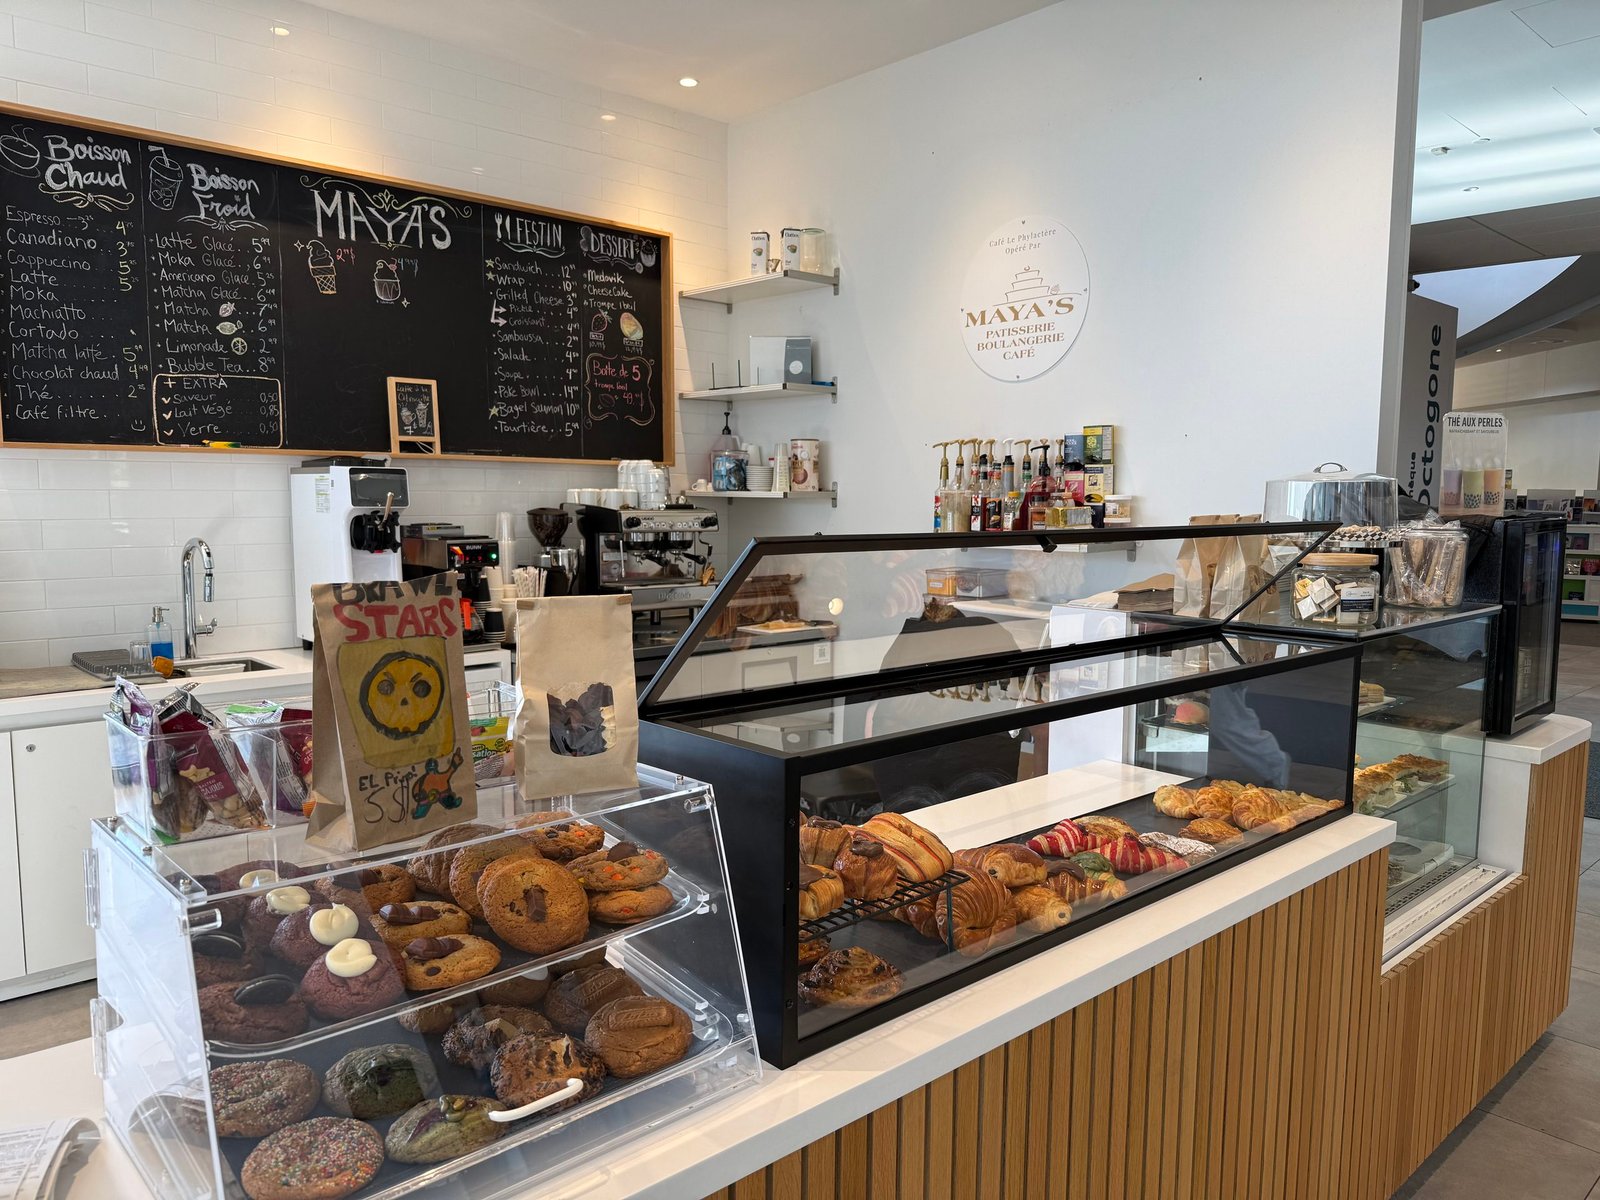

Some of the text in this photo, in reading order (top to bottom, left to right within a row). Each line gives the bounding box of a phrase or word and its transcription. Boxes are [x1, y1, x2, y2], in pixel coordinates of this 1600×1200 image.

[43, 135, 132, 166] Boisson
[45, 161, 128, 190] Chaud
[186, 163, 260, 195] Boisson
[192, 191, 255, 219] Froid
[6, 204, 61, 227] Espresso
[310, 189, 451, 250] MAYA'S
[7, 228, 97, 249] Canadiano
[516, 217, 562, 248] FESTIN
[202, 235, 235, 252] Glacé
[591, 231, 636, 259] DESSERT
[989, 237, 1005, 248] Café
[1007, 236, 1016, 244] Le
[1005, 241, 1041, 255] Opéré Par
[7, 249, 91, 271] Cappuccino
[158, 251, 195, 267] Moka
[201, 252, 236, 268] Glacé
[495, 257, 542, 275] Sandwich
[10, 268, 59, 287] Latte
[160, 267, 216, 282] Americano
[496, 273, 526, 287] Wrap
[10, 284, 59, 302] Moka
[161, 285, 206, 300] Matcha
[211, 286, 241, 300] Glacé
[496, 288, 528, 304] Grilled
[534, 291, 564, 306] Cheese
[10, 303, 86, 320] Machiatto
[164, 301, 212, 317] Matcha
[965, 297, 1074, 328] MAYA'S
[9, 321, 79, 340] Cortado
[164, 318, 212, 335] Matcha
[508, 317, 545, 328] Croissant
[986, 321, 1056, 340] PATISSERIE
[12, 342, 67, 360] Matcha
[166, 338, 228, 354] Limonade
[977, 332, 1065, 352] BOULANGERIE
[497, 347, 532, 361] Salade
[1002, 347, 1035, 361] CAFÉ
[12, 364, 75, 381] Chocolat
[80, 363, 120, 381] chaud
[166, 355, 218, 373] Bubble
[218, 357, 244, 373] Tea
[632, 364, 641, 381] 5
[497, 366, 524, 381] Soupe
[16, 382, 53, 401] Thé
[183, 377, 228, 390] EXTRA
[173, 394, 216, 404] Saveur
[16, 403, 49, 419] Café
[175, 403, 198, 418] Lait
[202, 400, 232, 418] Végé
[497, 401, 527, 419] Bagel
[178, 421, 221, 437] Verre
[497, 420, 548, 433] Tourtière
[1448, 415, 1503, 428] THÉ AUX PERLES
[333, 598, 458, 642] STARS
[359, 774, 379, 791] EL
